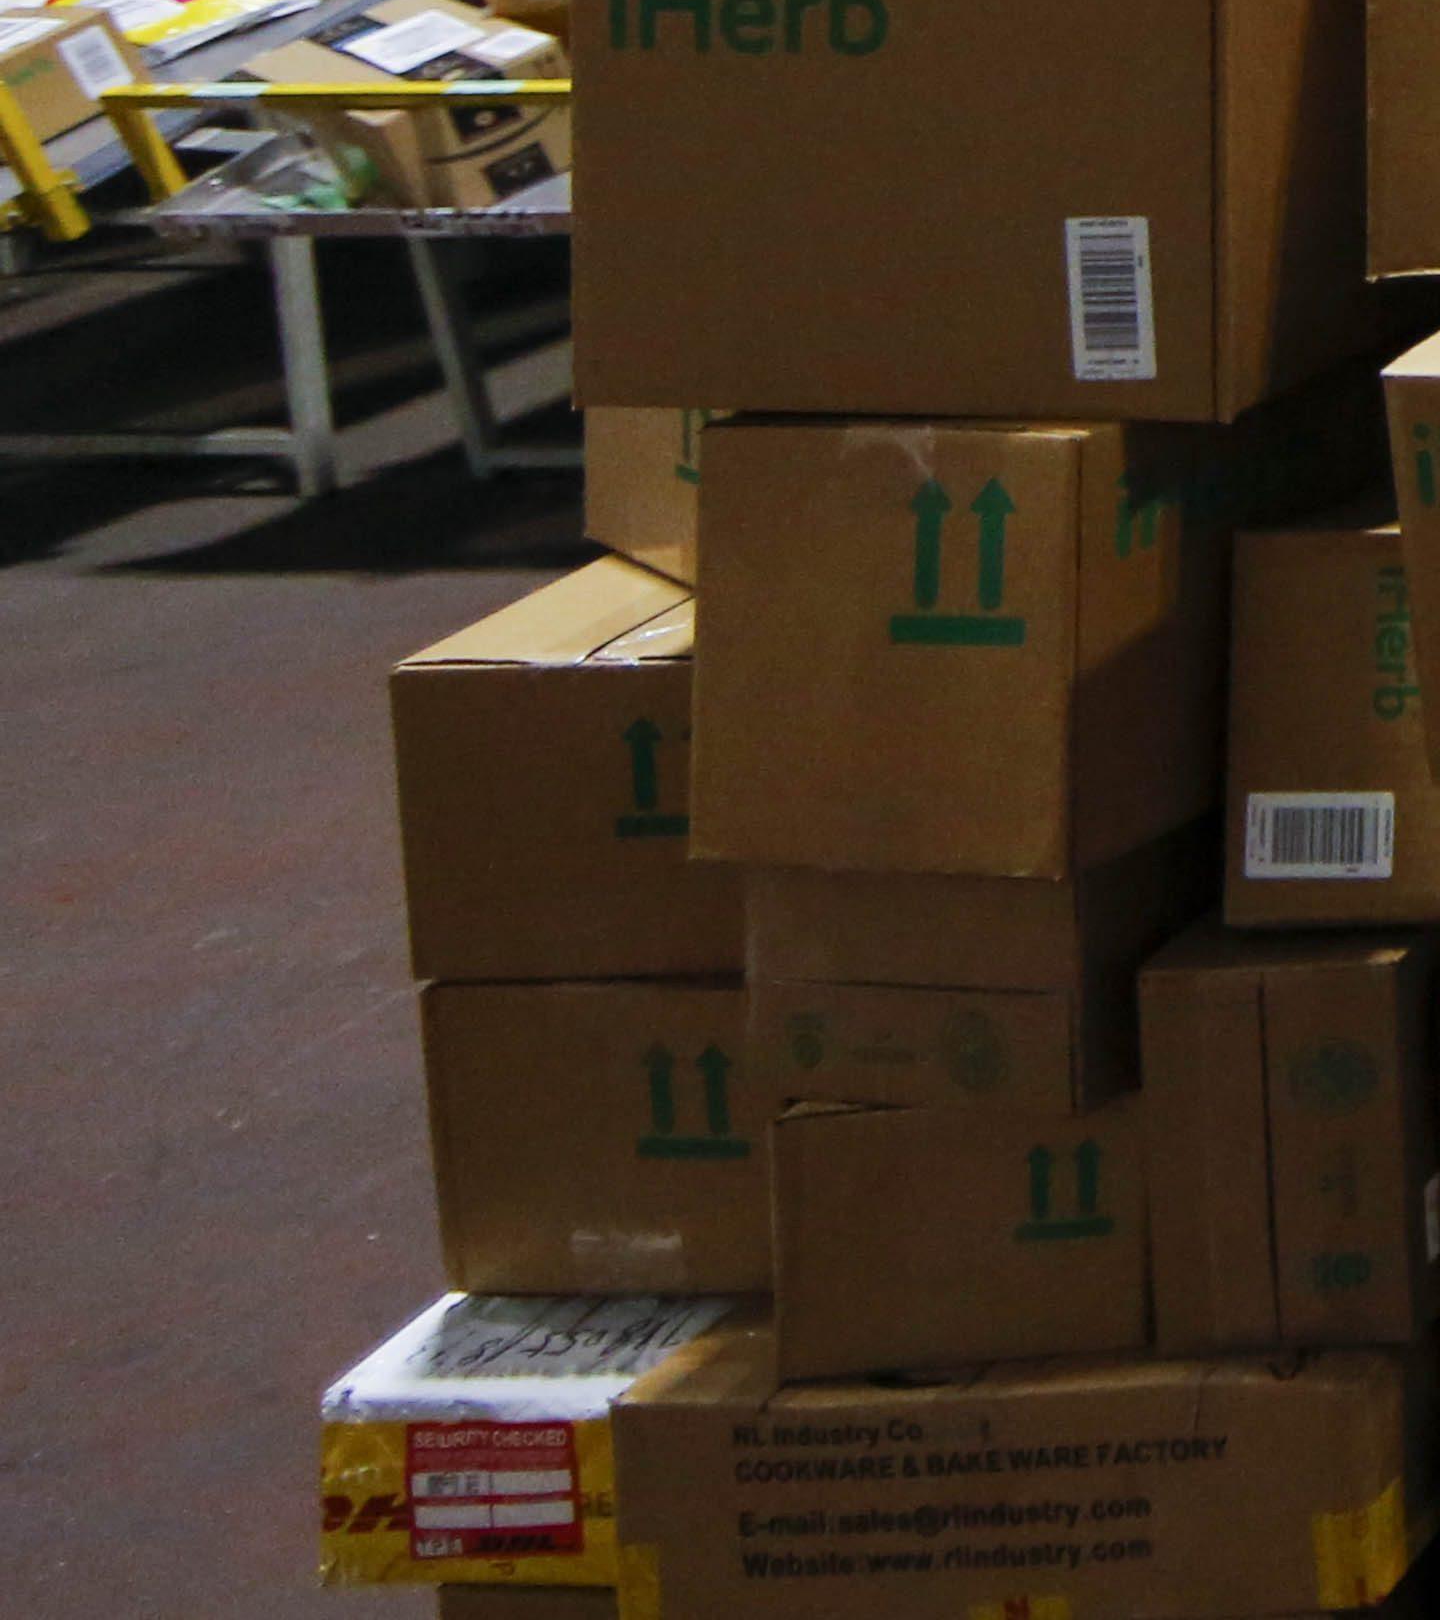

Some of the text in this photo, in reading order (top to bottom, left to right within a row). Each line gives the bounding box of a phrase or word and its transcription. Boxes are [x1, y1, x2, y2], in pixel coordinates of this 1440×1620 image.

[493, 1428, 567, 1447] CHECKED
[736, 1456, 896, 1484] COOKWARE
[1096, 1435, 1228, 1466] FACTORY
